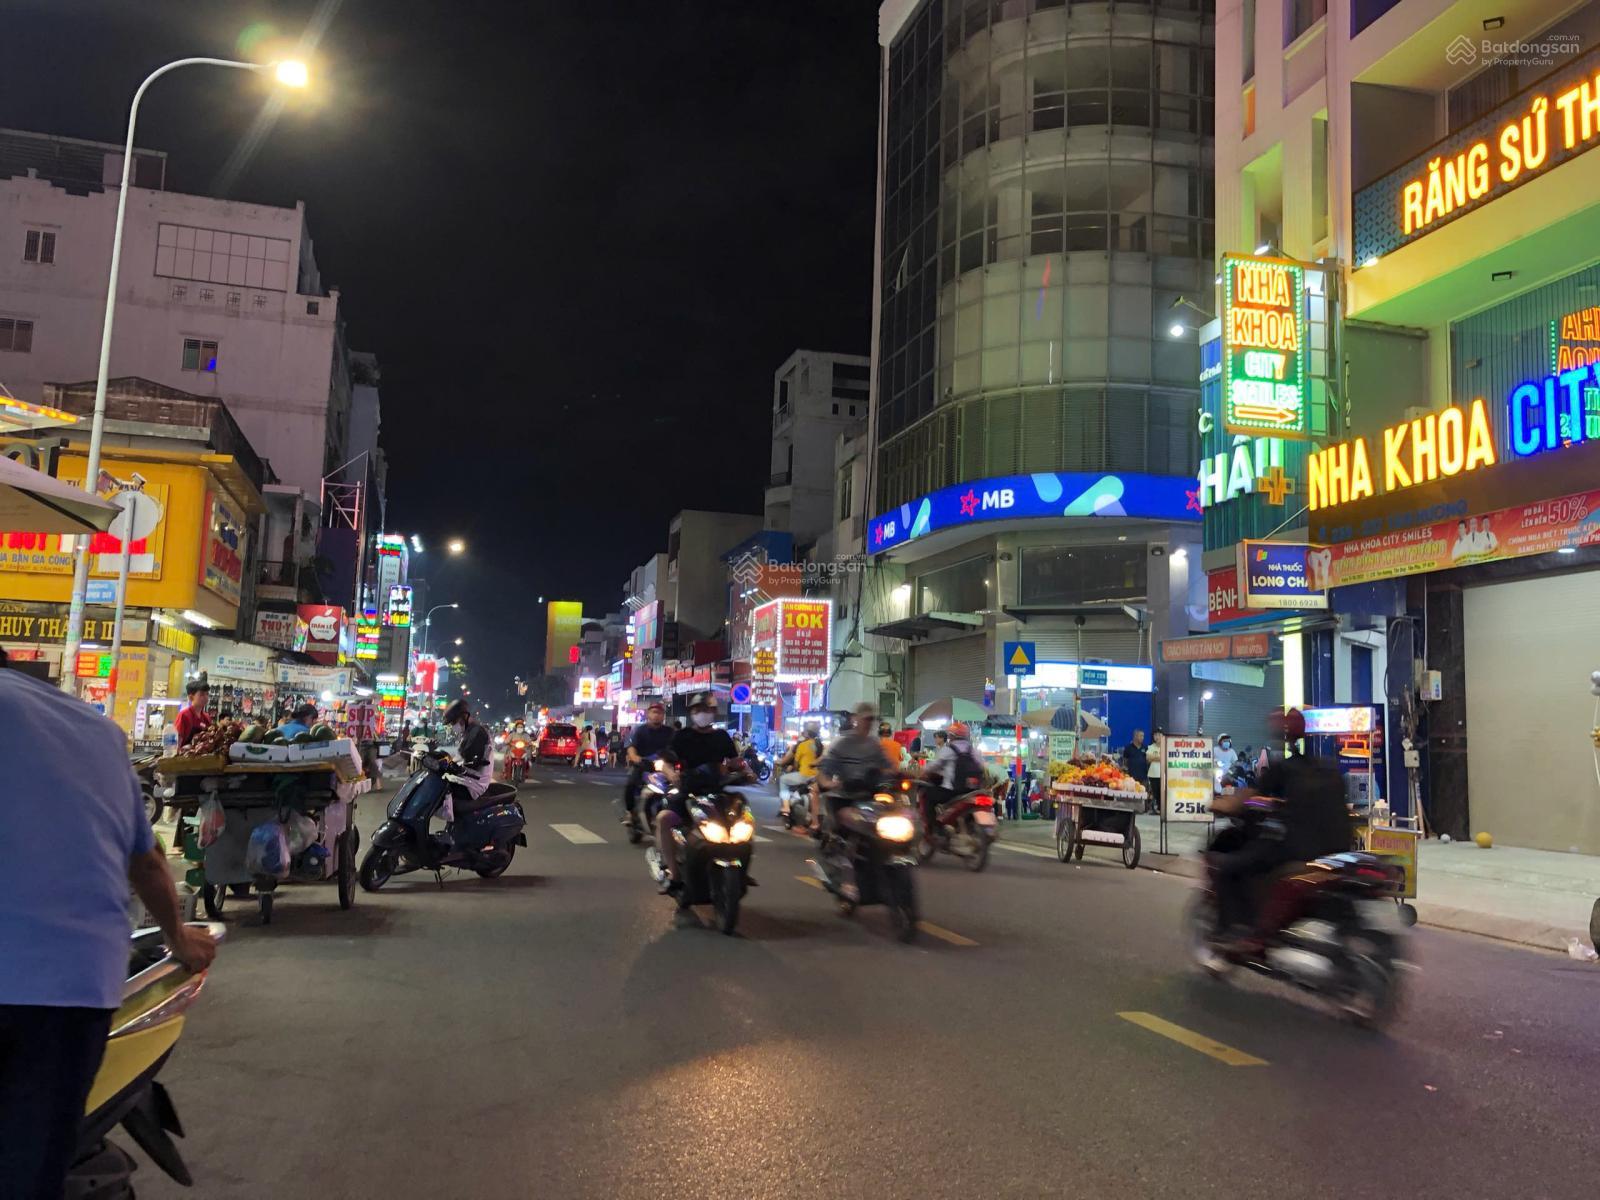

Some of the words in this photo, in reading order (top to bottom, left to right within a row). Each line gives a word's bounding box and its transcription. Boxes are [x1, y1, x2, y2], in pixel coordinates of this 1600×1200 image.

[1403, 143, 1489, 235] RĂNG
[1500, 96, 1548, 182] SỨ
[1237, 264, 1290, 306] NHA
[1231, 307, 1298, 350] KHOA
[1308, 438, 1374, 511] NHA
[1383, 399, 1496, 492] KHOA
[981, 488, 1015, 510] MB
[1548, 495, 1588, 525] 50%
[884, 521, 896, 539] MB
[1343, 543, 1359, 554] NHA
[1360, 538, 1381, 551] KHOA
[1382, 533, 1400, 546] CITY
[1402, 527, 1432, 541] SMILES
[1252, 576, 1285, 587] LONG
[0, 616, 35, 636] HUY
[38, 614, 96, 640] THÀH
[784, 612, 824, 630] 10K
